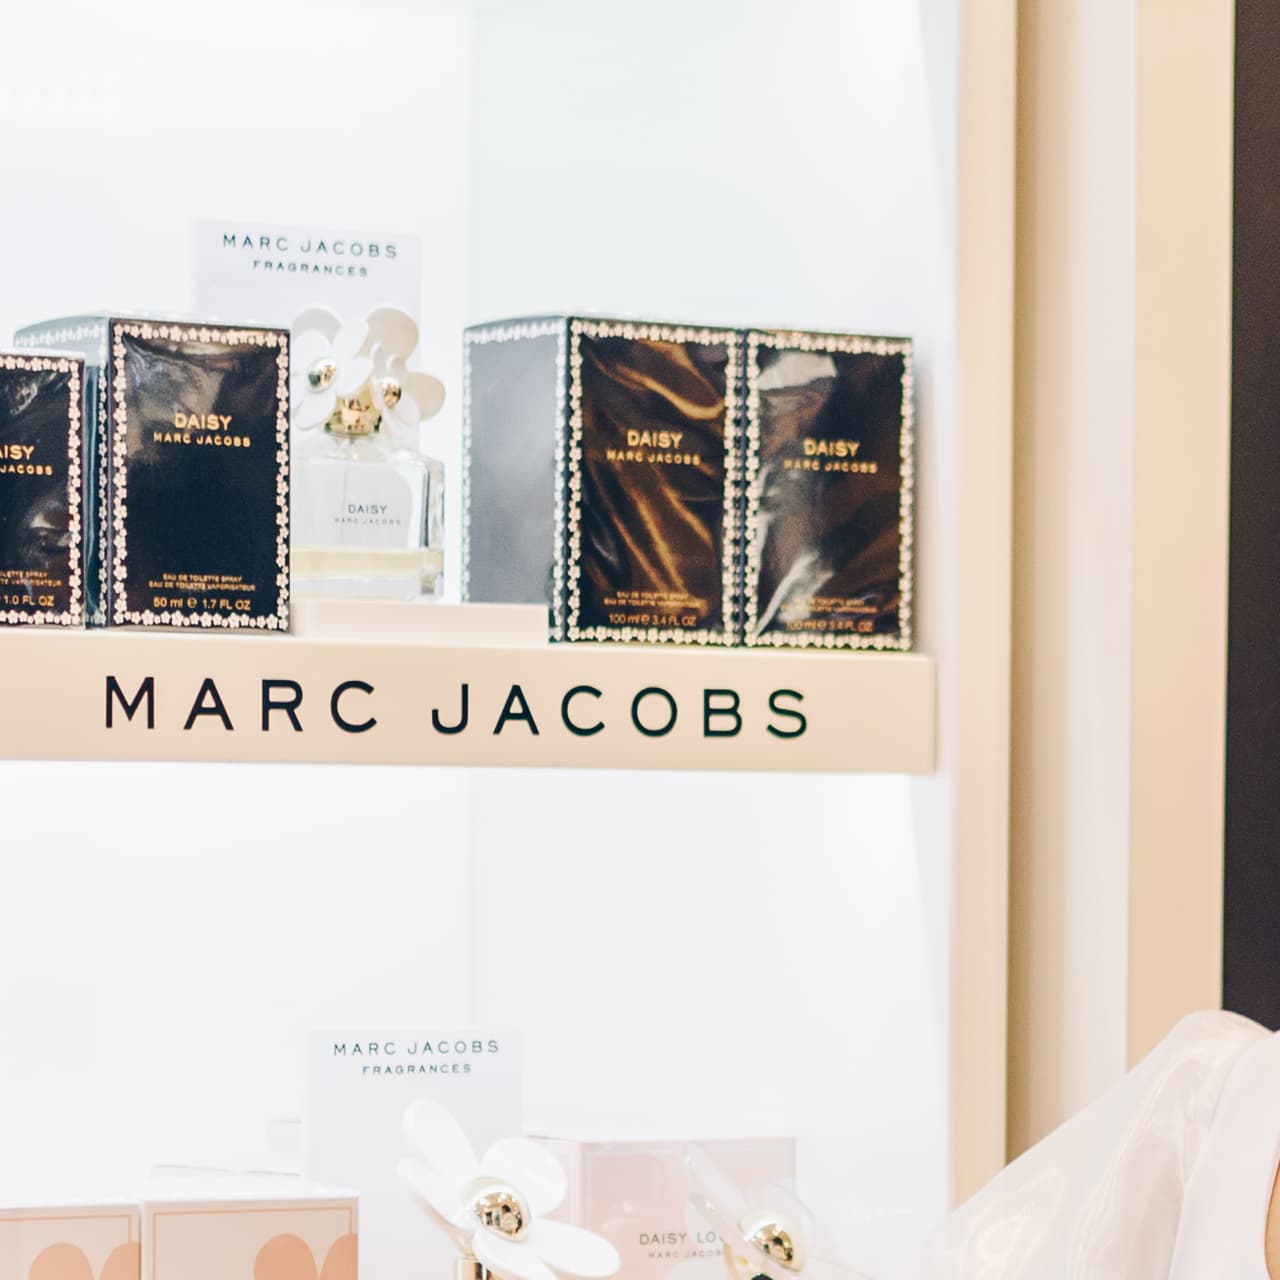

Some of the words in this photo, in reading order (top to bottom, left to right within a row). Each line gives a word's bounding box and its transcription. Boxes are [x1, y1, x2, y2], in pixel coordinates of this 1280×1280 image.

[222, 233, 289, 252] MARC
[300, 239, 398, 259] JACOBS
[253, 260, 368, 277] FRAGRANCES
[174, 412, 233, 431] DAISY
[152, 431, 192, 445] MARC
[196, 435, 251, 448] JACOBS
[626, 428, 683, 449] DAISY
[803, 437, 860, 457] DAISY
[605, 448, 644, 462] MARC
[647, 453, 701, 466] JACOBS
[0, 464, 53, 476] JACOBS
[783, 459, 820, 471] MARC
[824, 462, 879, 474] JACOBS
[347, 503, 388, 515] DAISY
[22, 595, 36, 606] FL
[38, 595, 55, 607] OZ
[153, 596, 168, 608] 50
[170, 597, 183, 608] ml
[203, 598, 217, 609] 1.7
[219, 599, 232, 610] FL
[234, 600, 252, 611] OZ
[105, 675, 378, 733] MARC
[431, 682, 808, 739] JACOBS
[333, 1042, 397, 1056] MARC
[408, 1040, 499, 1054] JACOBS
[362, 1063, 472, 1076] FRAGRANCES
[639, 1231, 688, 1246] DAISY
